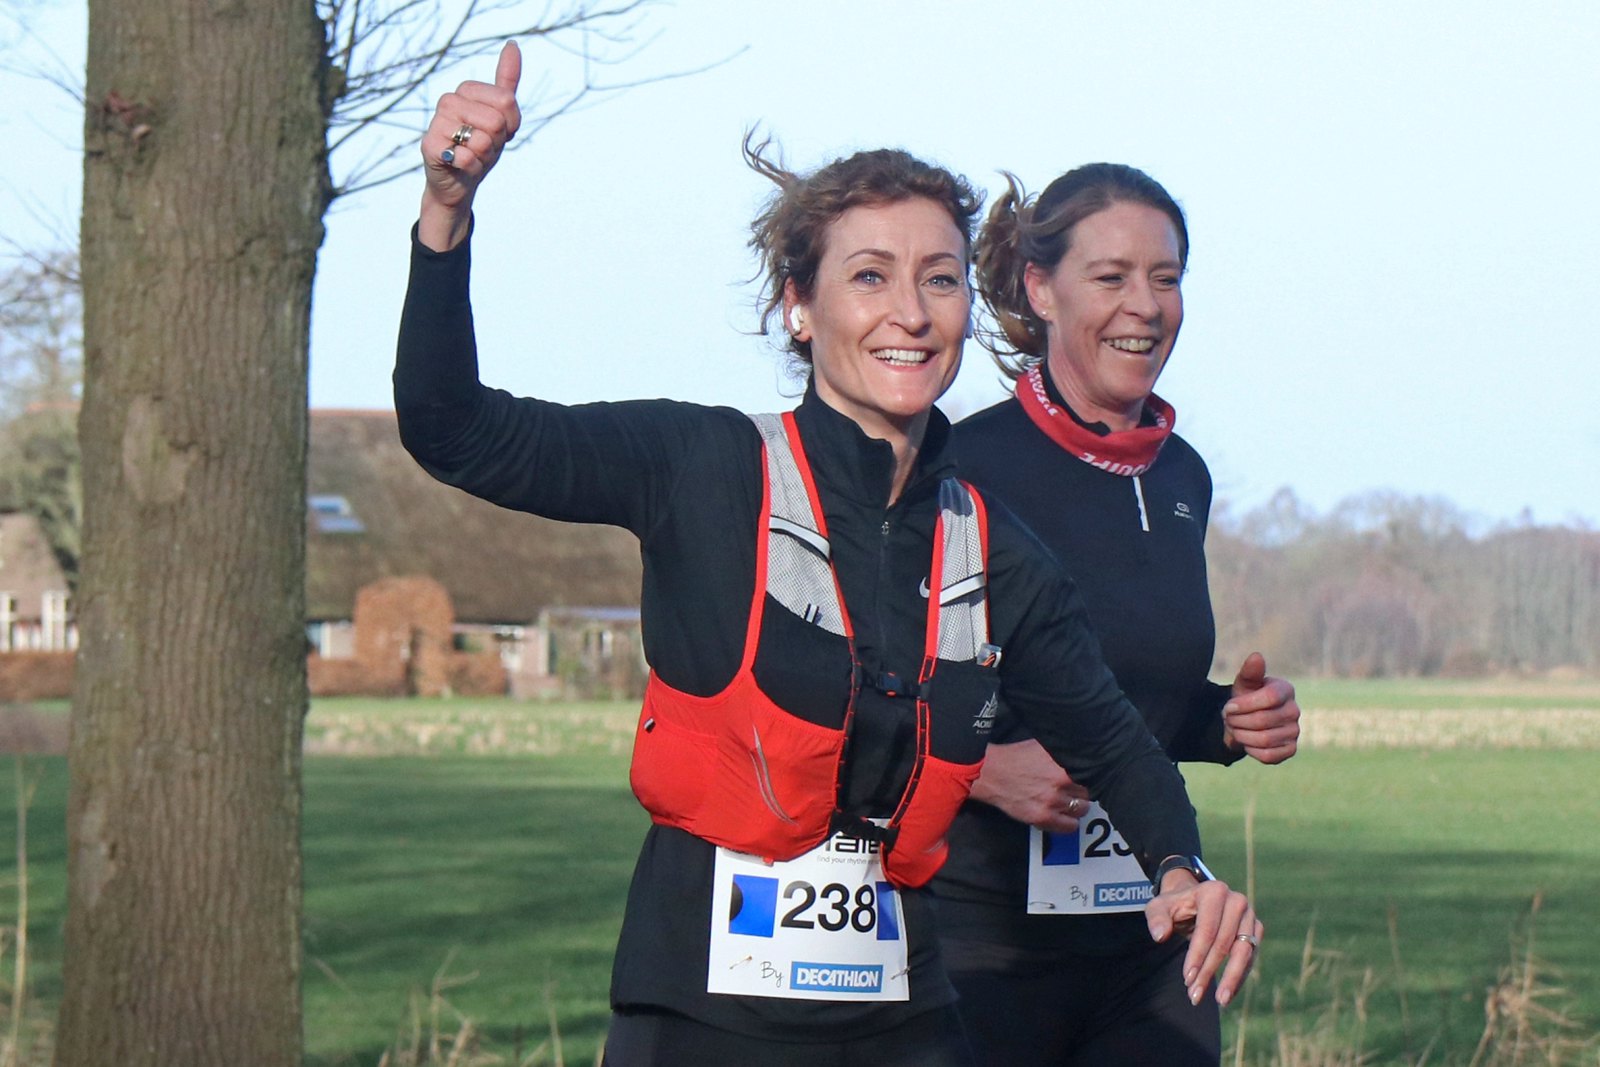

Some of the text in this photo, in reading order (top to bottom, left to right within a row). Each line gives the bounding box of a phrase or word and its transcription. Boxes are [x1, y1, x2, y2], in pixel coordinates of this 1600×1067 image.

[831, 857, 846, 865] your
[781, 880, 876, 932] 238
[1070, 885, 1088, 907] By
[761, 961, 879, 987] By DECATHLON
